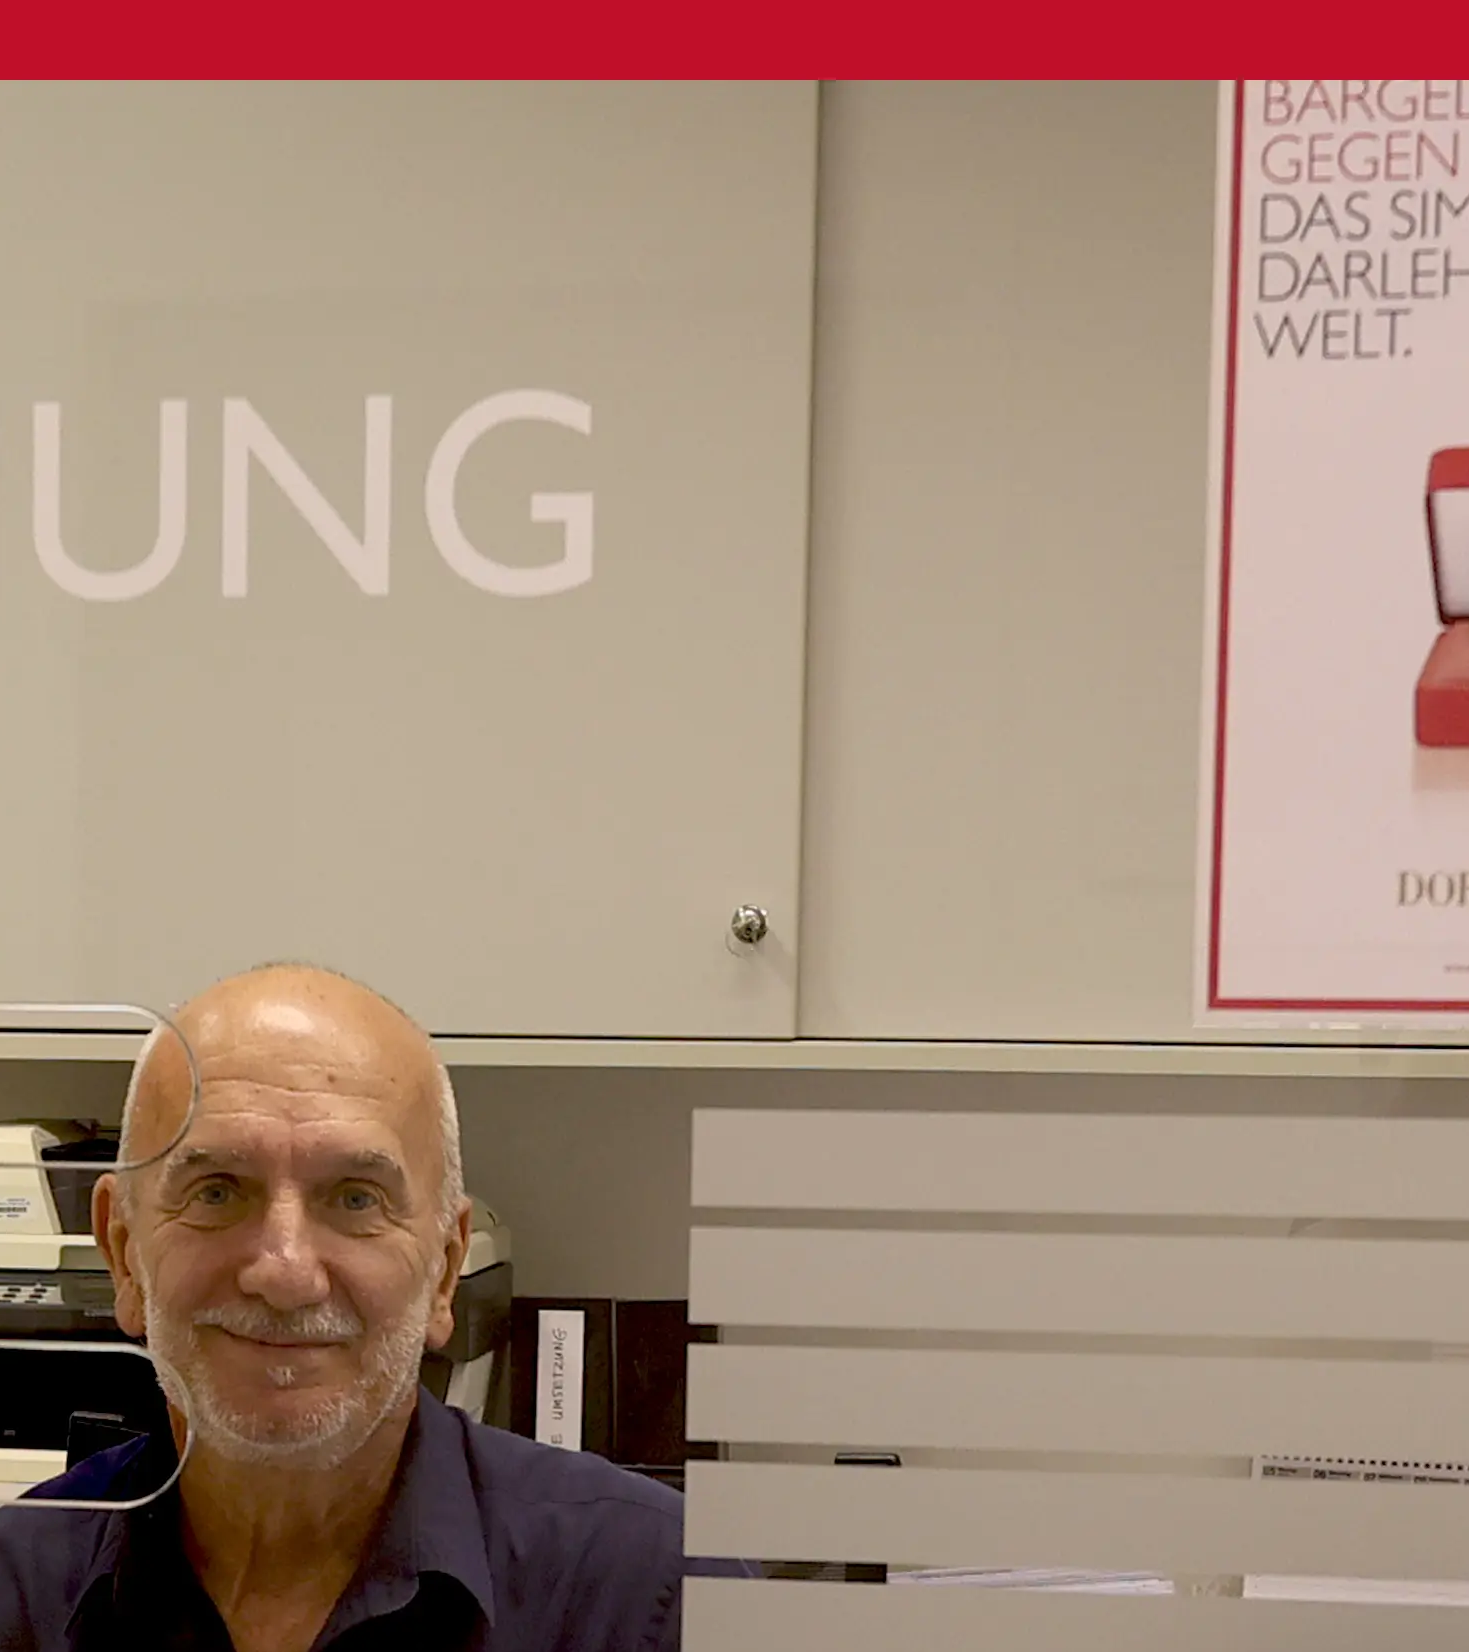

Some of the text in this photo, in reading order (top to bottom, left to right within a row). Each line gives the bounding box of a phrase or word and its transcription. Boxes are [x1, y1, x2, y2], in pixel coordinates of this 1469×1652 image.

[1261, 128, 1462, 185] GEGEN
[1259, 190, 1373, 245] DAS
[1253, 307, 1413, 360] WELT.
